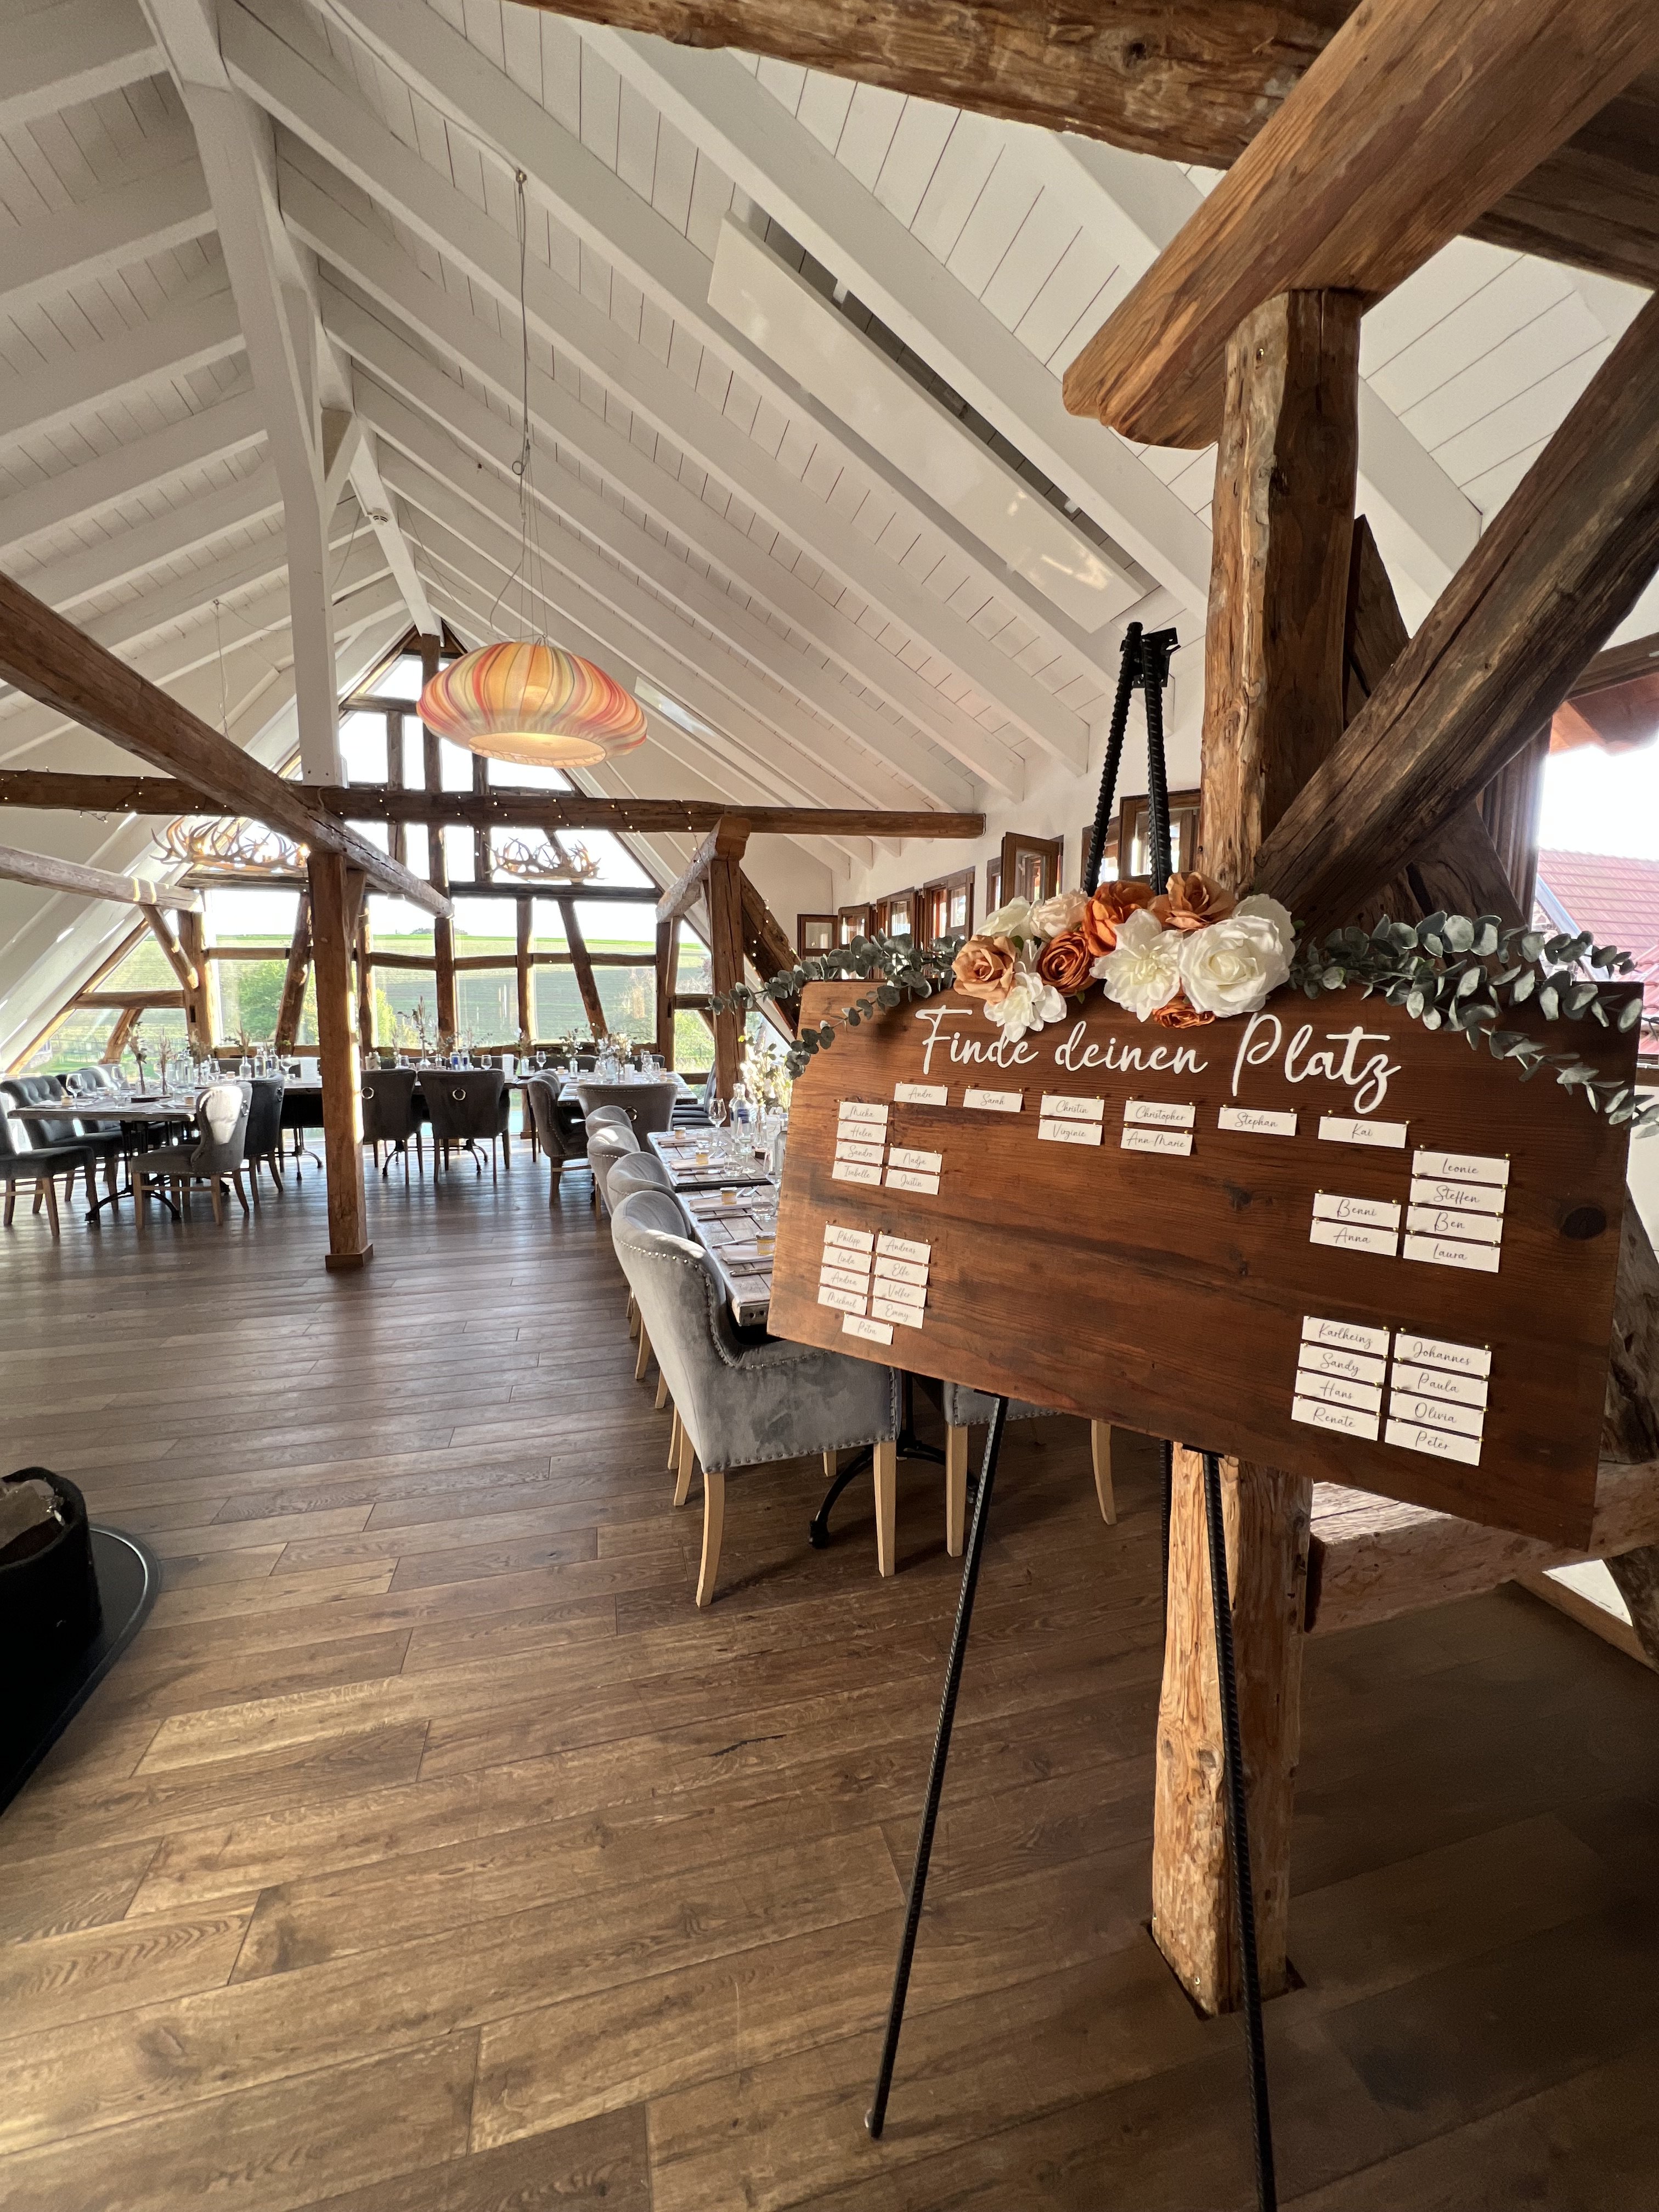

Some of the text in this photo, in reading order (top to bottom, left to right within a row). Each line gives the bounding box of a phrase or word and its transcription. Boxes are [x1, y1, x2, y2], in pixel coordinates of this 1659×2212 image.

[1054, 1020, 1208, 1074] deinen
[1232, 1012, 1402, 1114] Platz
[980, 1093, 1005, 1107] Sarah
[1056, 1100, 1088, 1114] Christin
[850, 1105, 874, 1118] Micha
[1135, 1105, 1186, 1124] Christopher
[1234, 1111, 1278, 1129] Stephan
[850, 1125, 873, 1137] Helen
[1052, 1123, 1087, 1140] Virginie
[1351, 1123, 1373, 1139] Kai
[847, 1144, 873, 1158] Sandro
[902, 1153, 927, 1169] Nadja
[1442, 1158, 1480, 1174] Leonie
[843, 1165, 871, 1178] Isabelle
[900, 1173, 923, 1187] Justin
[1433, 1184, 1481, 1205] Steffen
[1336, 1198, 1377, 1218] Benni
[1434, 1211, 1465, 1232] Ben
[837, 1230, 861, 1247] Philipp
[1333, 1227, 1371, 1244] Anna
[885, 1239, 916, 1254] Andreas
[1432, 1243, 1468, 1260] Laura
[837, 1255, 855, 1265] Linda
[831, 1271, 857, 1285] Andrea
[891, 1263, 910, 1276] Elke
[888, 1284, 911, 1298] Volker
[827, 1292, 856, 1308] Michael
[885, 1304, 909, 1322] Emmy
[857, 1321, 877, 1335] Petra
[1318, 1322, 1374, 1349] Karlheinz
[1412, 1341, 1471, 1366] Johannes
[1319, 1352, 1361, 1377] Sandy
[1319, 1380, 1354, 1400] Hans
[1417, 1372, 1459, 1393] Paula
[1312, 1406, 1356, 1428] Renate
[1414, 1402, 1457, 1424] Olivia
[1414, 1430, 1451, 1451] Peter
